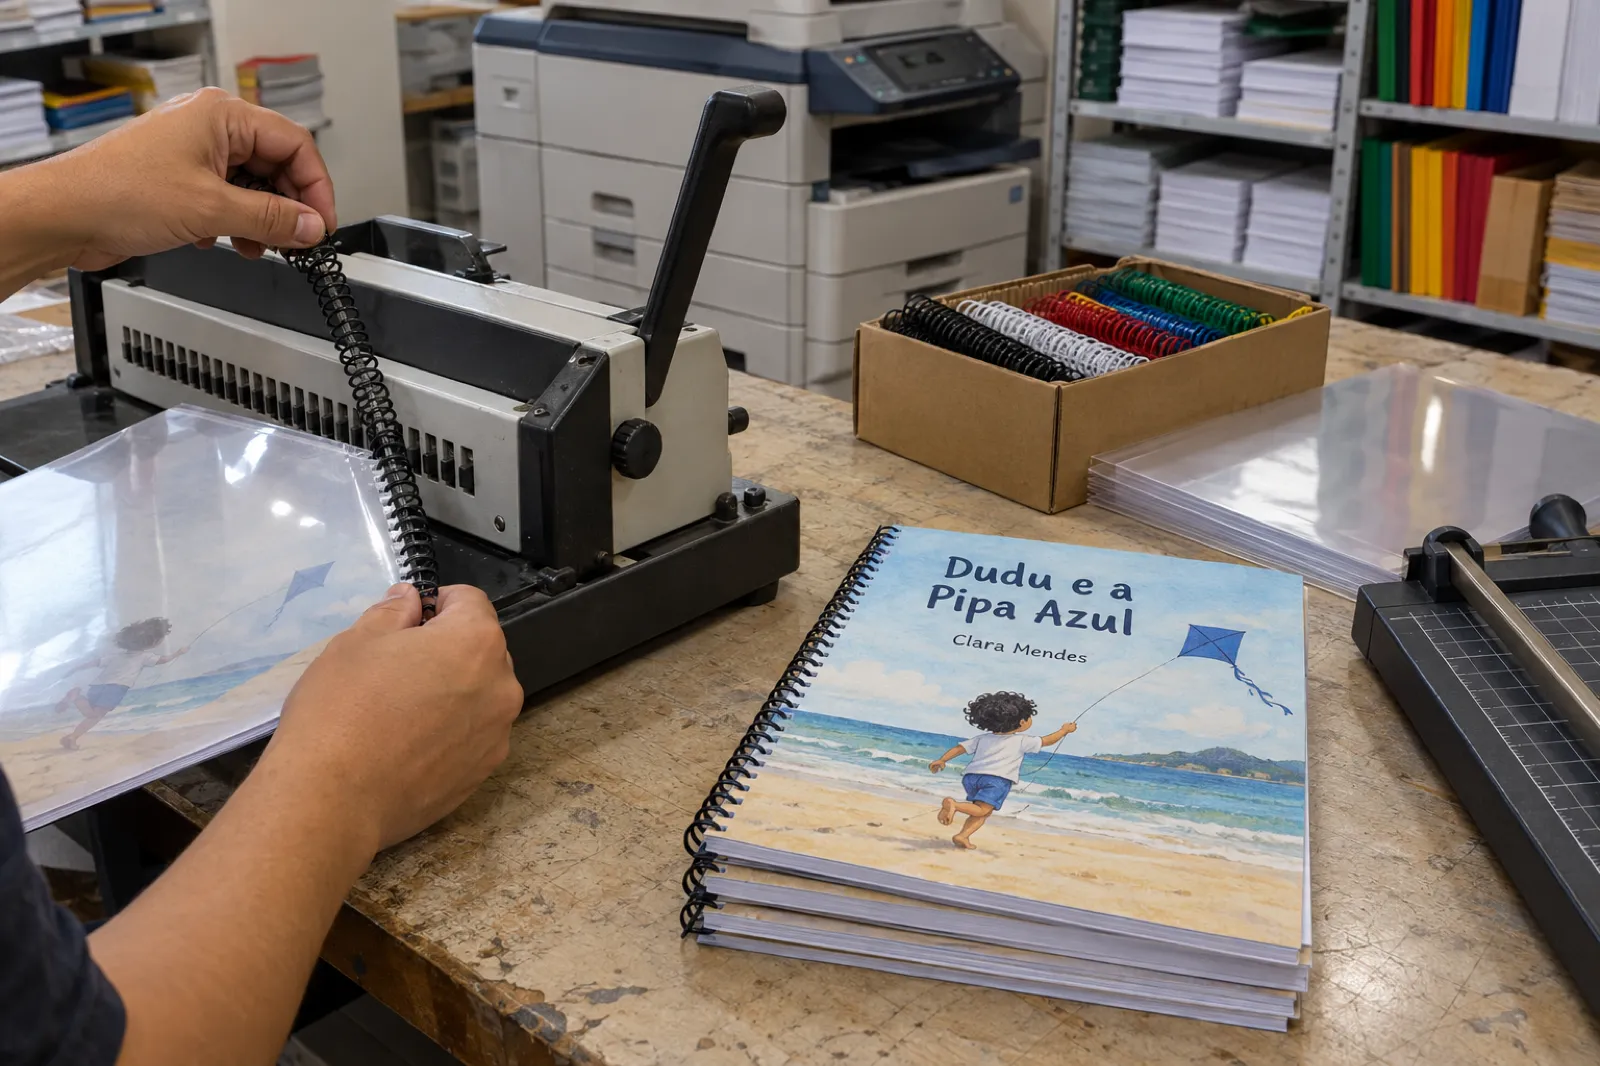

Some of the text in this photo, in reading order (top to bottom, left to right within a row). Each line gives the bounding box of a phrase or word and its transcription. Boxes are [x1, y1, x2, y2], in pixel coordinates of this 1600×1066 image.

[944, 555, 1133, 602] Dudu e a
[926, 584, 1133, 636] Pipa Azul
[952, 634, 1088, 664] Clara Mendes
